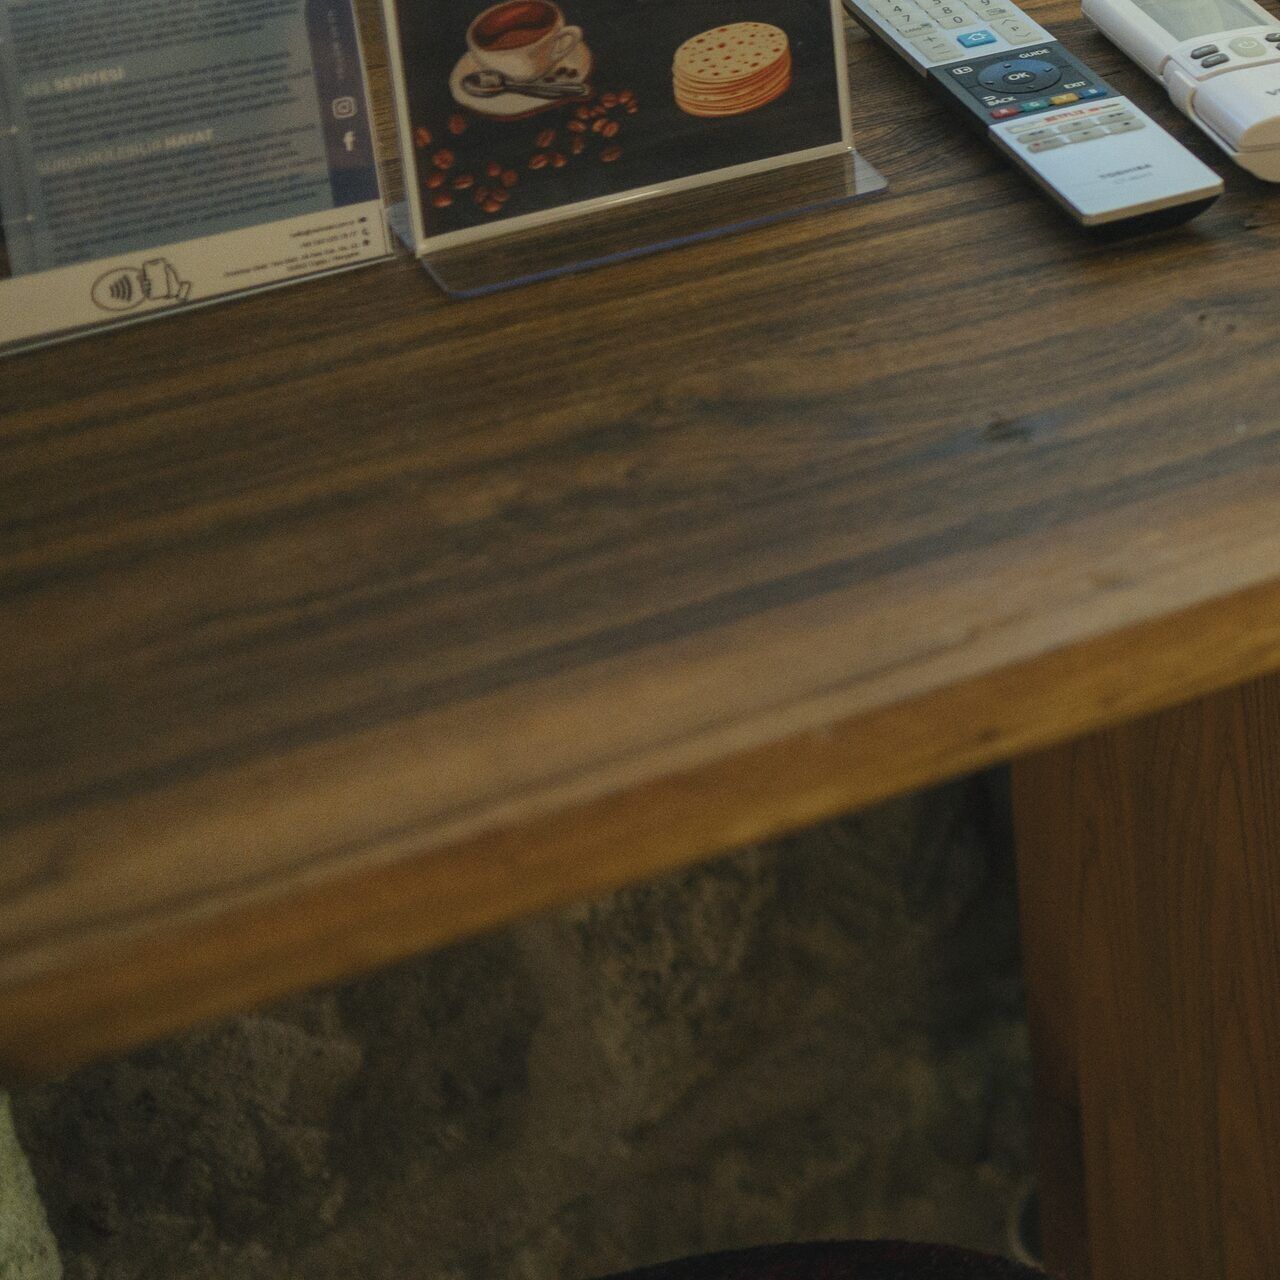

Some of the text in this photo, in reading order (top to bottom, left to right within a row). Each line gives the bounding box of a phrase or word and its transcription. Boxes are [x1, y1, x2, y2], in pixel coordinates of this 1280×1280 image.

[893, 5, 902, 13] 4
[902, 14, 911, 22] 7
[942, 7, 952, 15] 8
[953, 16, 963, 24] 0
[1019, 48, 1050, 59] GUIDE
[1007, 71, 1030, 81] OK
[1063, 80, 1087, 90] EXIT
[987, 95, 1017, 107] BACK
